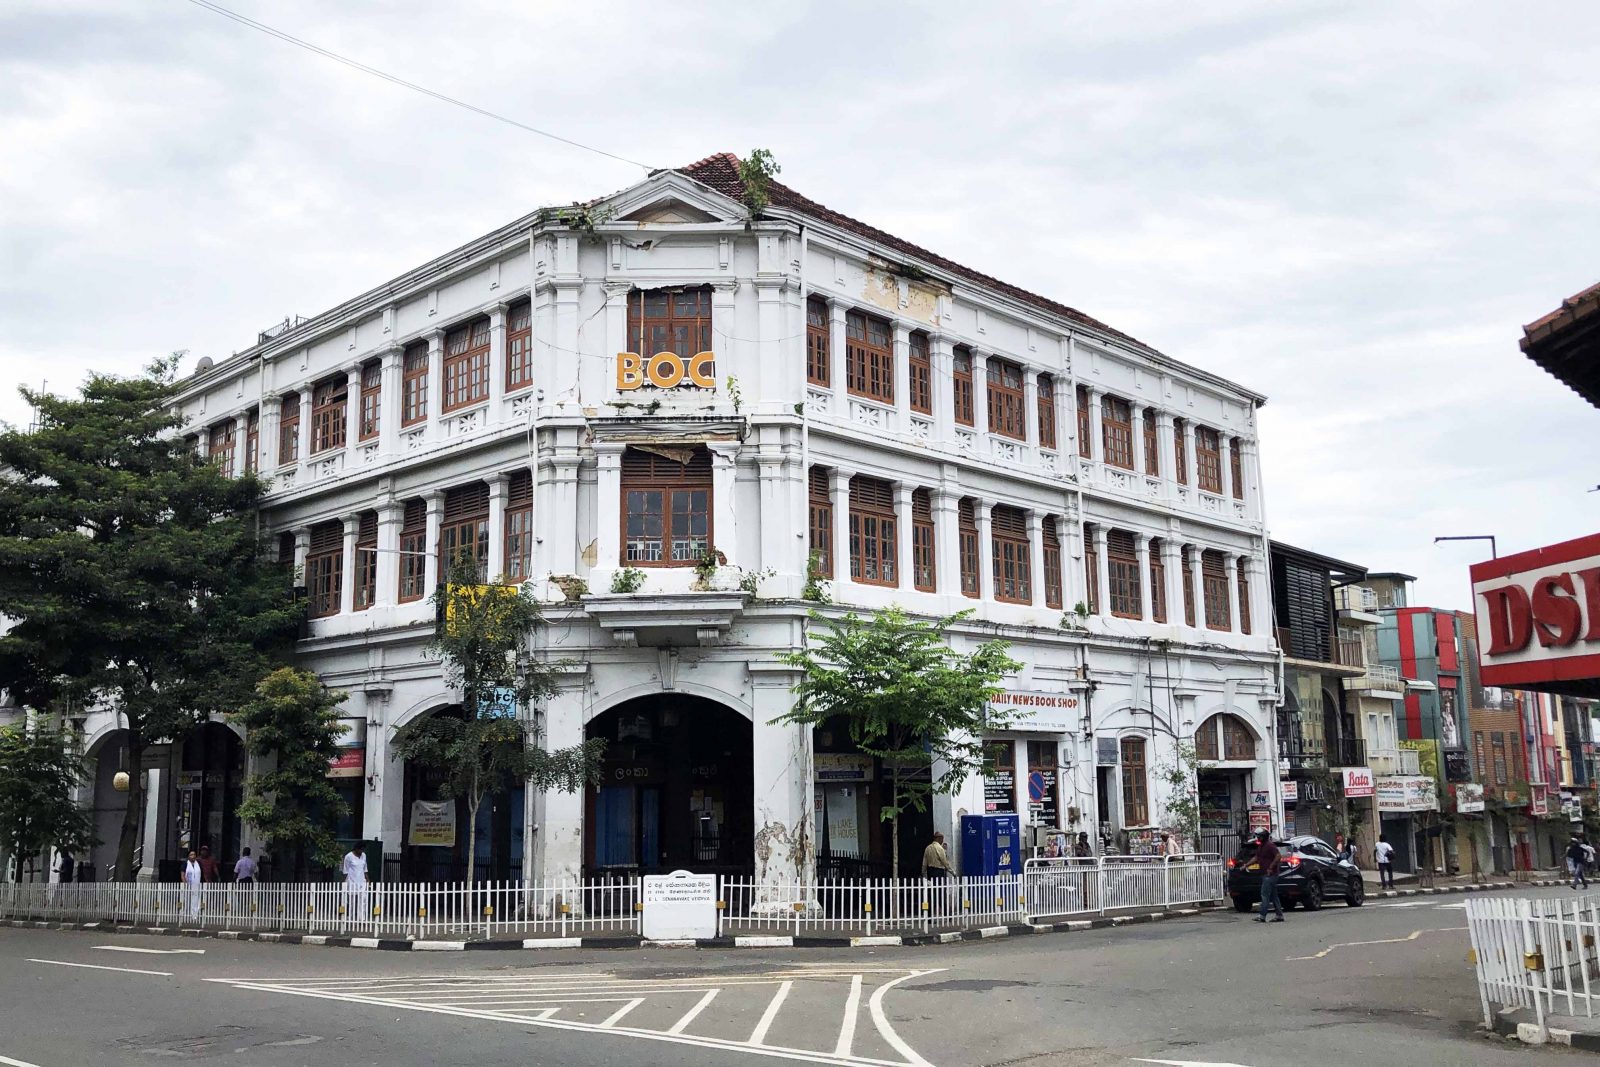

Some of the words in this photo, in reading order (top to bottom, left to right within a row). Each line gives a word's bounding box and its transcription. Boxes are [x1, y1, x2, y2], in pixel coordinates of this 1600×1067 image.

[617, 352, 715, 389] BOC
[991, 693, 1011, 704] DAILY
[1012, 694, 1034, 706] NEWS
[1035, 696, 1056, 707] BOOK
[1057, 697, 1078, 709] SHOP
[1348, 771, 1369, 786] Bata
